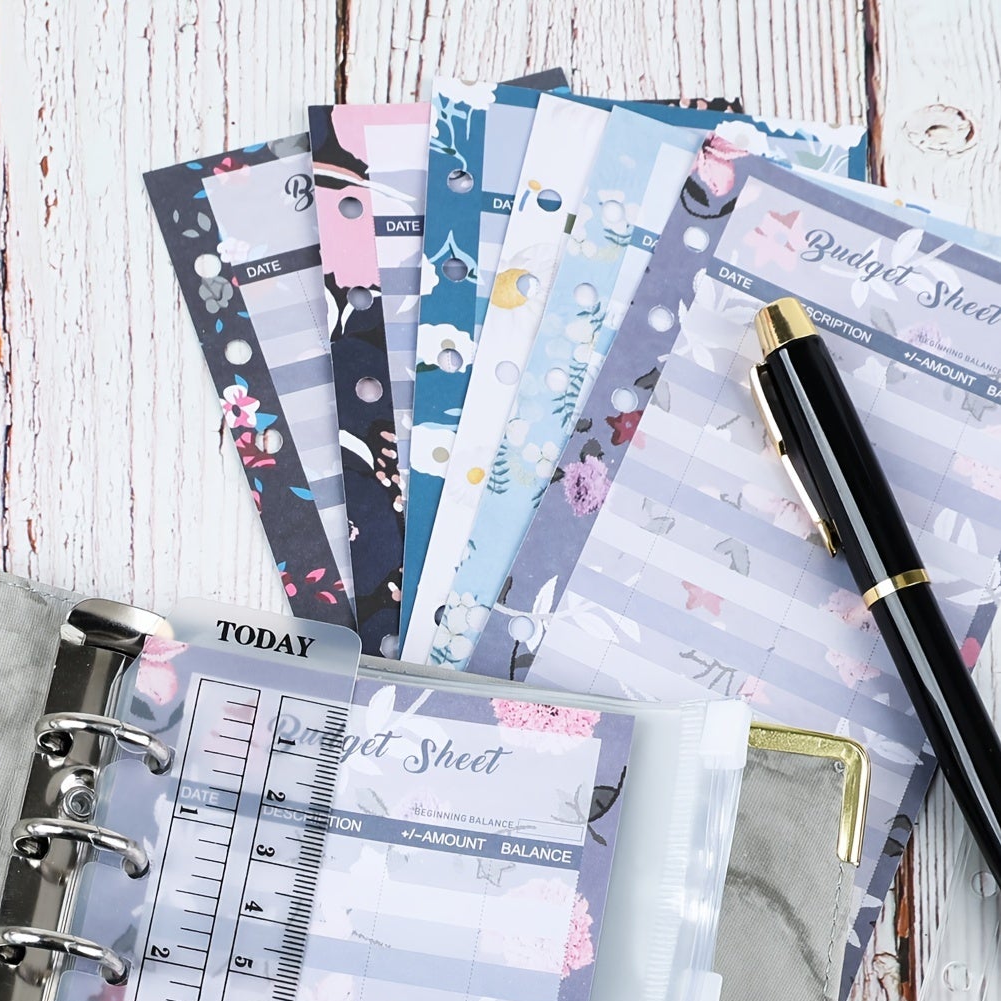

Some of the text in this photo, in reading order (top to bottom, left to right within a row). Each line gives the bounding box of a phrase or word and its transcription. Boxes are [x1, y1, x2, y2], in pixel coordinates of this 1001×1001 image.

[493, 198, 513, 210] DA
[386, 220, 420, 233] DATE
[246, 259, 282, 278] DATE
[799, 228, 1001, 326] Budget Sheet
[718, 266, 754, 290] DATE
[801, 303, 872, 343] SCRIPTION
[918, 334, 963, 359] BEGINNING
[217, 620, 316, 658] TODAY
[278, 736, 296, 746] 1
[403, 738, 513, 775] Sheet
[267, 789, 286, 804] 2
[179, 805, 199, 815] 1
[181, 786, 220, 805] DATE
[501, 842, 572, 864] BALANCE
[414, 807, 514, 829] BEGINNING BALANCE
[256, 844, 275, 858] 3
[244, 900, 264, 913] 4
[150, 944, 170, 958] 2
[234, 955, 254, 969] 5
